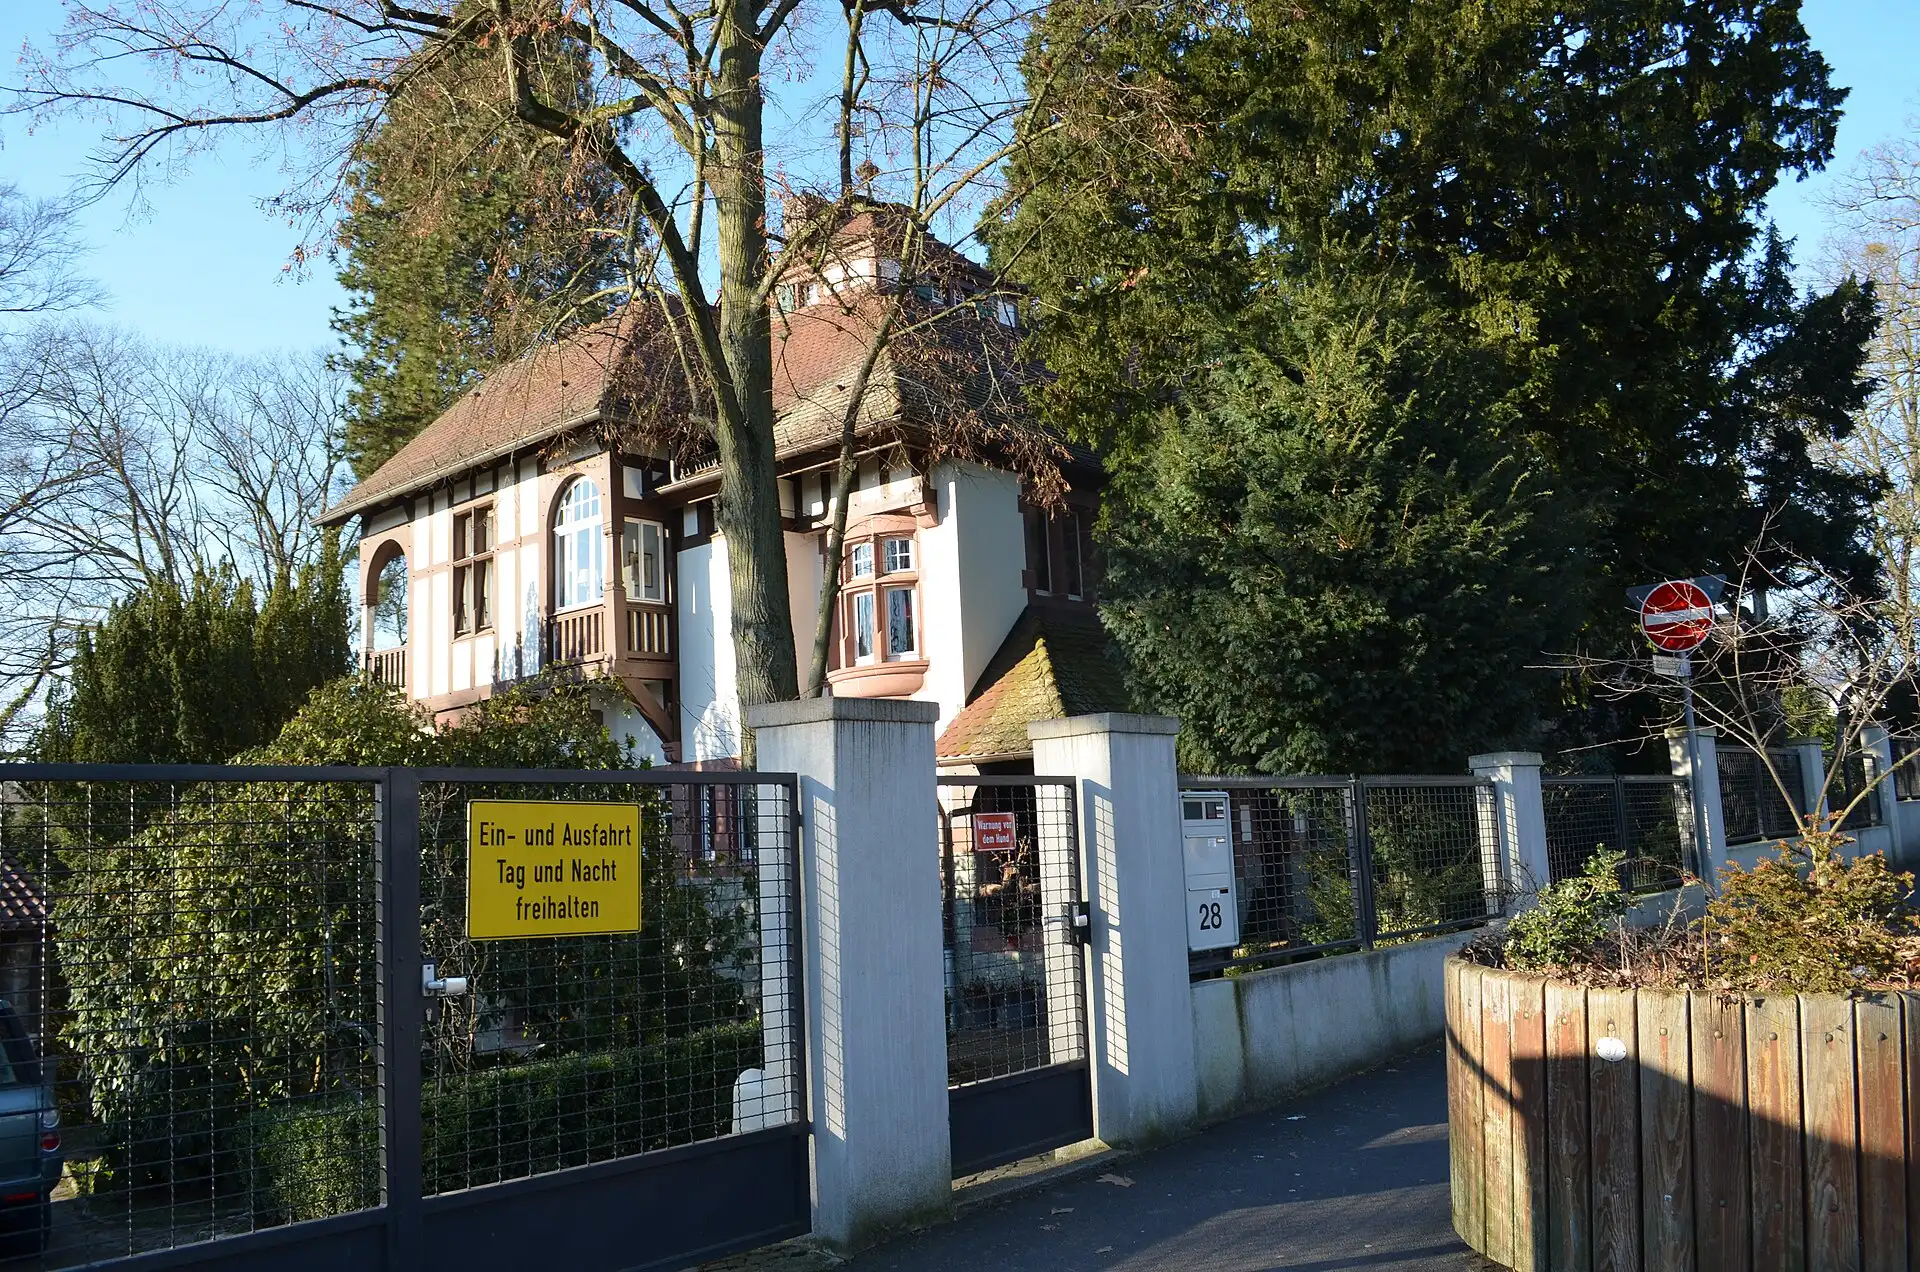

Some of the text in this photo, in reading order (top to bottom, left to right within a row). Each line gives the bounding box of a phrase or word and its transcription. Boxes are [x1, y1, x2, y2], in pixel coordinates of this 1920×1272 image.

[480, 822, 632, 846] Ein- und Ausfahrt
[977, 820, 1012, 831] Warnung vor
[982, 833, 1010, 844] dem Hund
[497, 859, 617, 890] Tag und Nacht
[516, 895, 599, 921] freihalten
[1199, 902, 1222, 931] 28
